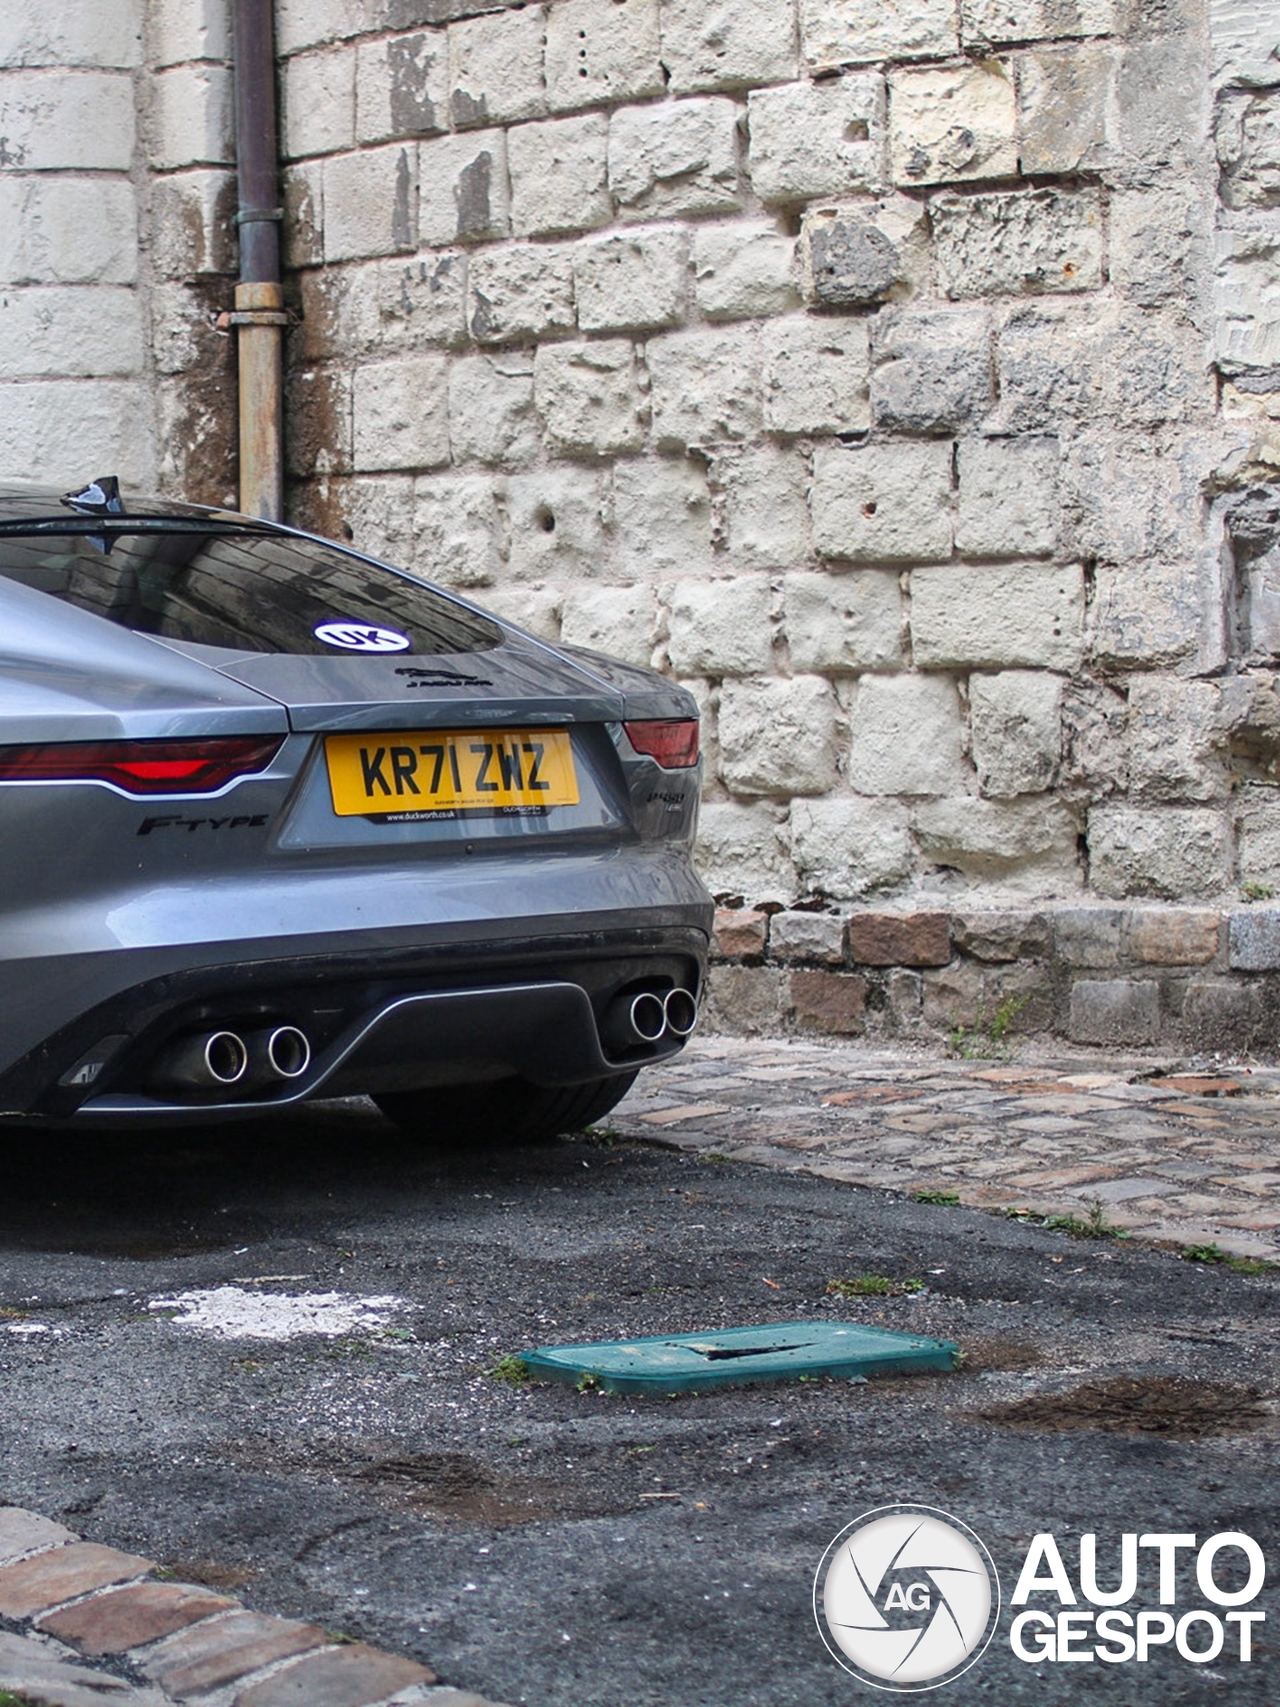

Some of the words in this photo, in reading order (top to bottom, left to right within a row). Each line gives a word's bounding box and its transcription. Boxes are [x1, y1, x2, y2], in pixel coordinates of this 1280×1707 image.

[322, 630, 403, 646] UK
[359, 744, 462, 797] KR71
[470, 743, 550, 792] ZWZ
[386, 810, 455, 822] www.duckworth.co.uk
